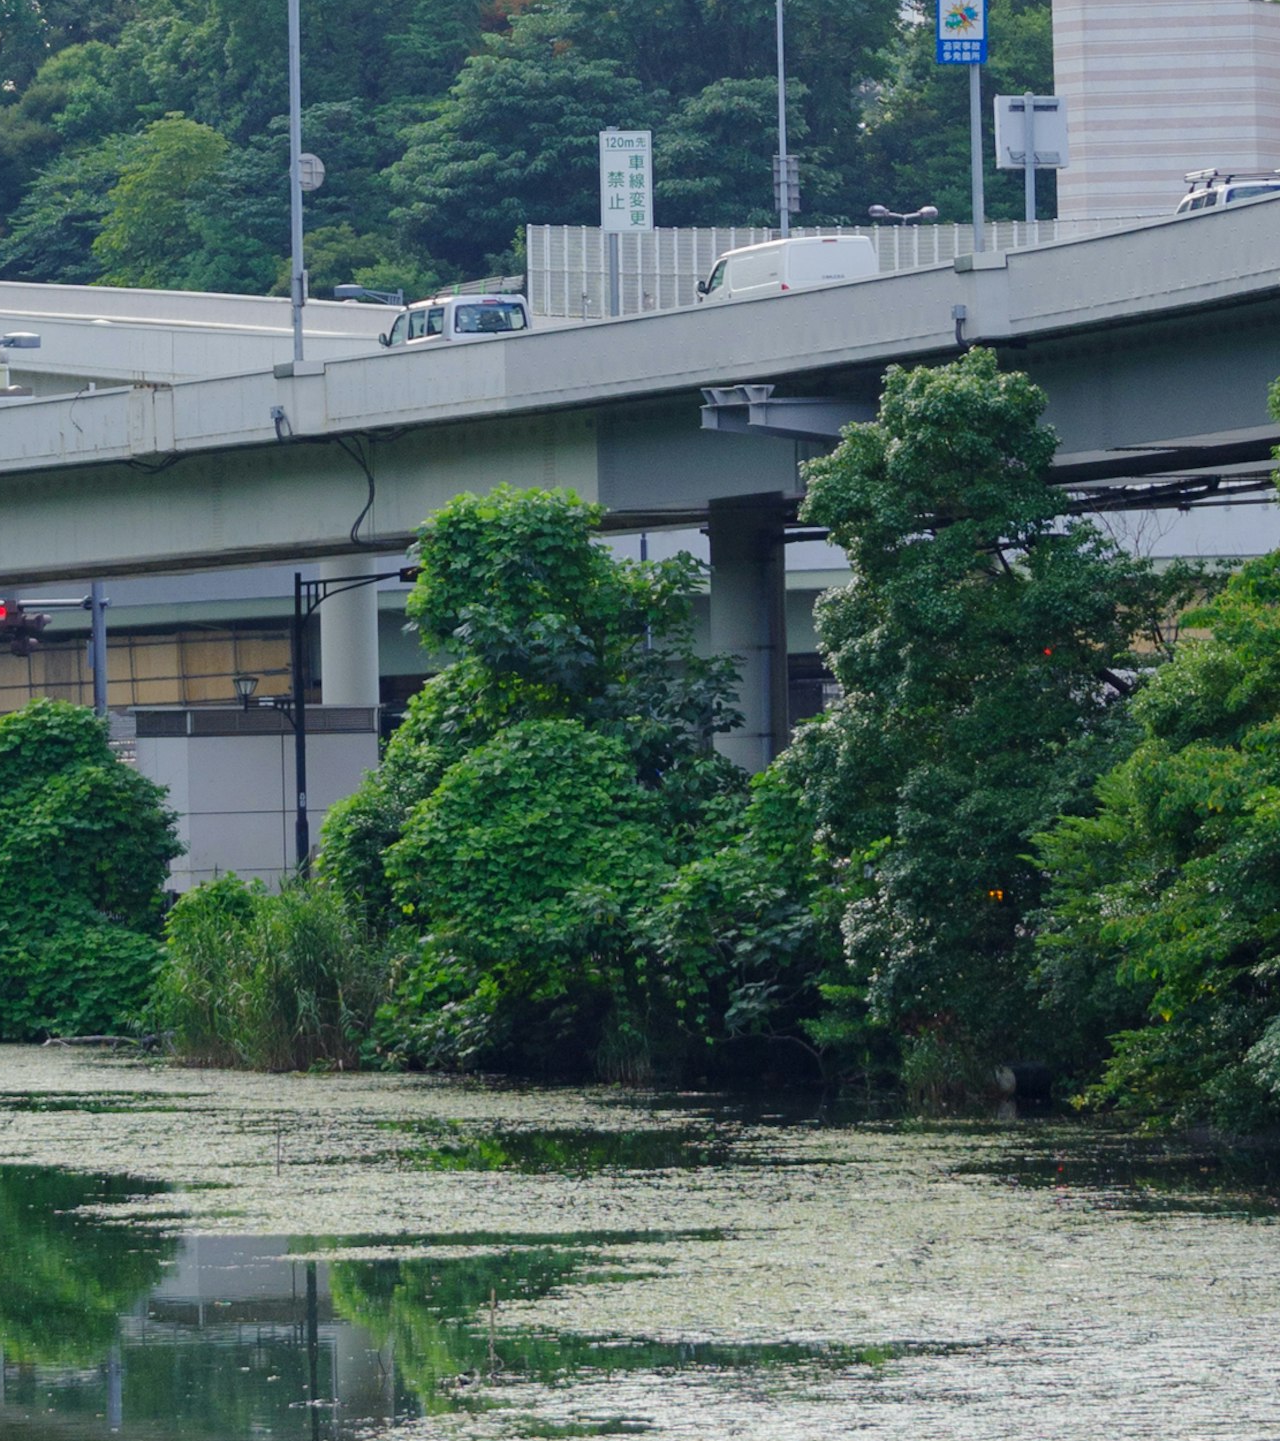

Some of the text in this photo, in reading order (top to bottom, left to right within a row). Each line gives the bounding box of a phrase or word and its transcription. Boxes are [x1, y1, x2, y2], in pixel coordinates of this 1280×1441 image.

[607, 171, 625, 210] 禁止
[628, 154, 646, 226] 車線変更
